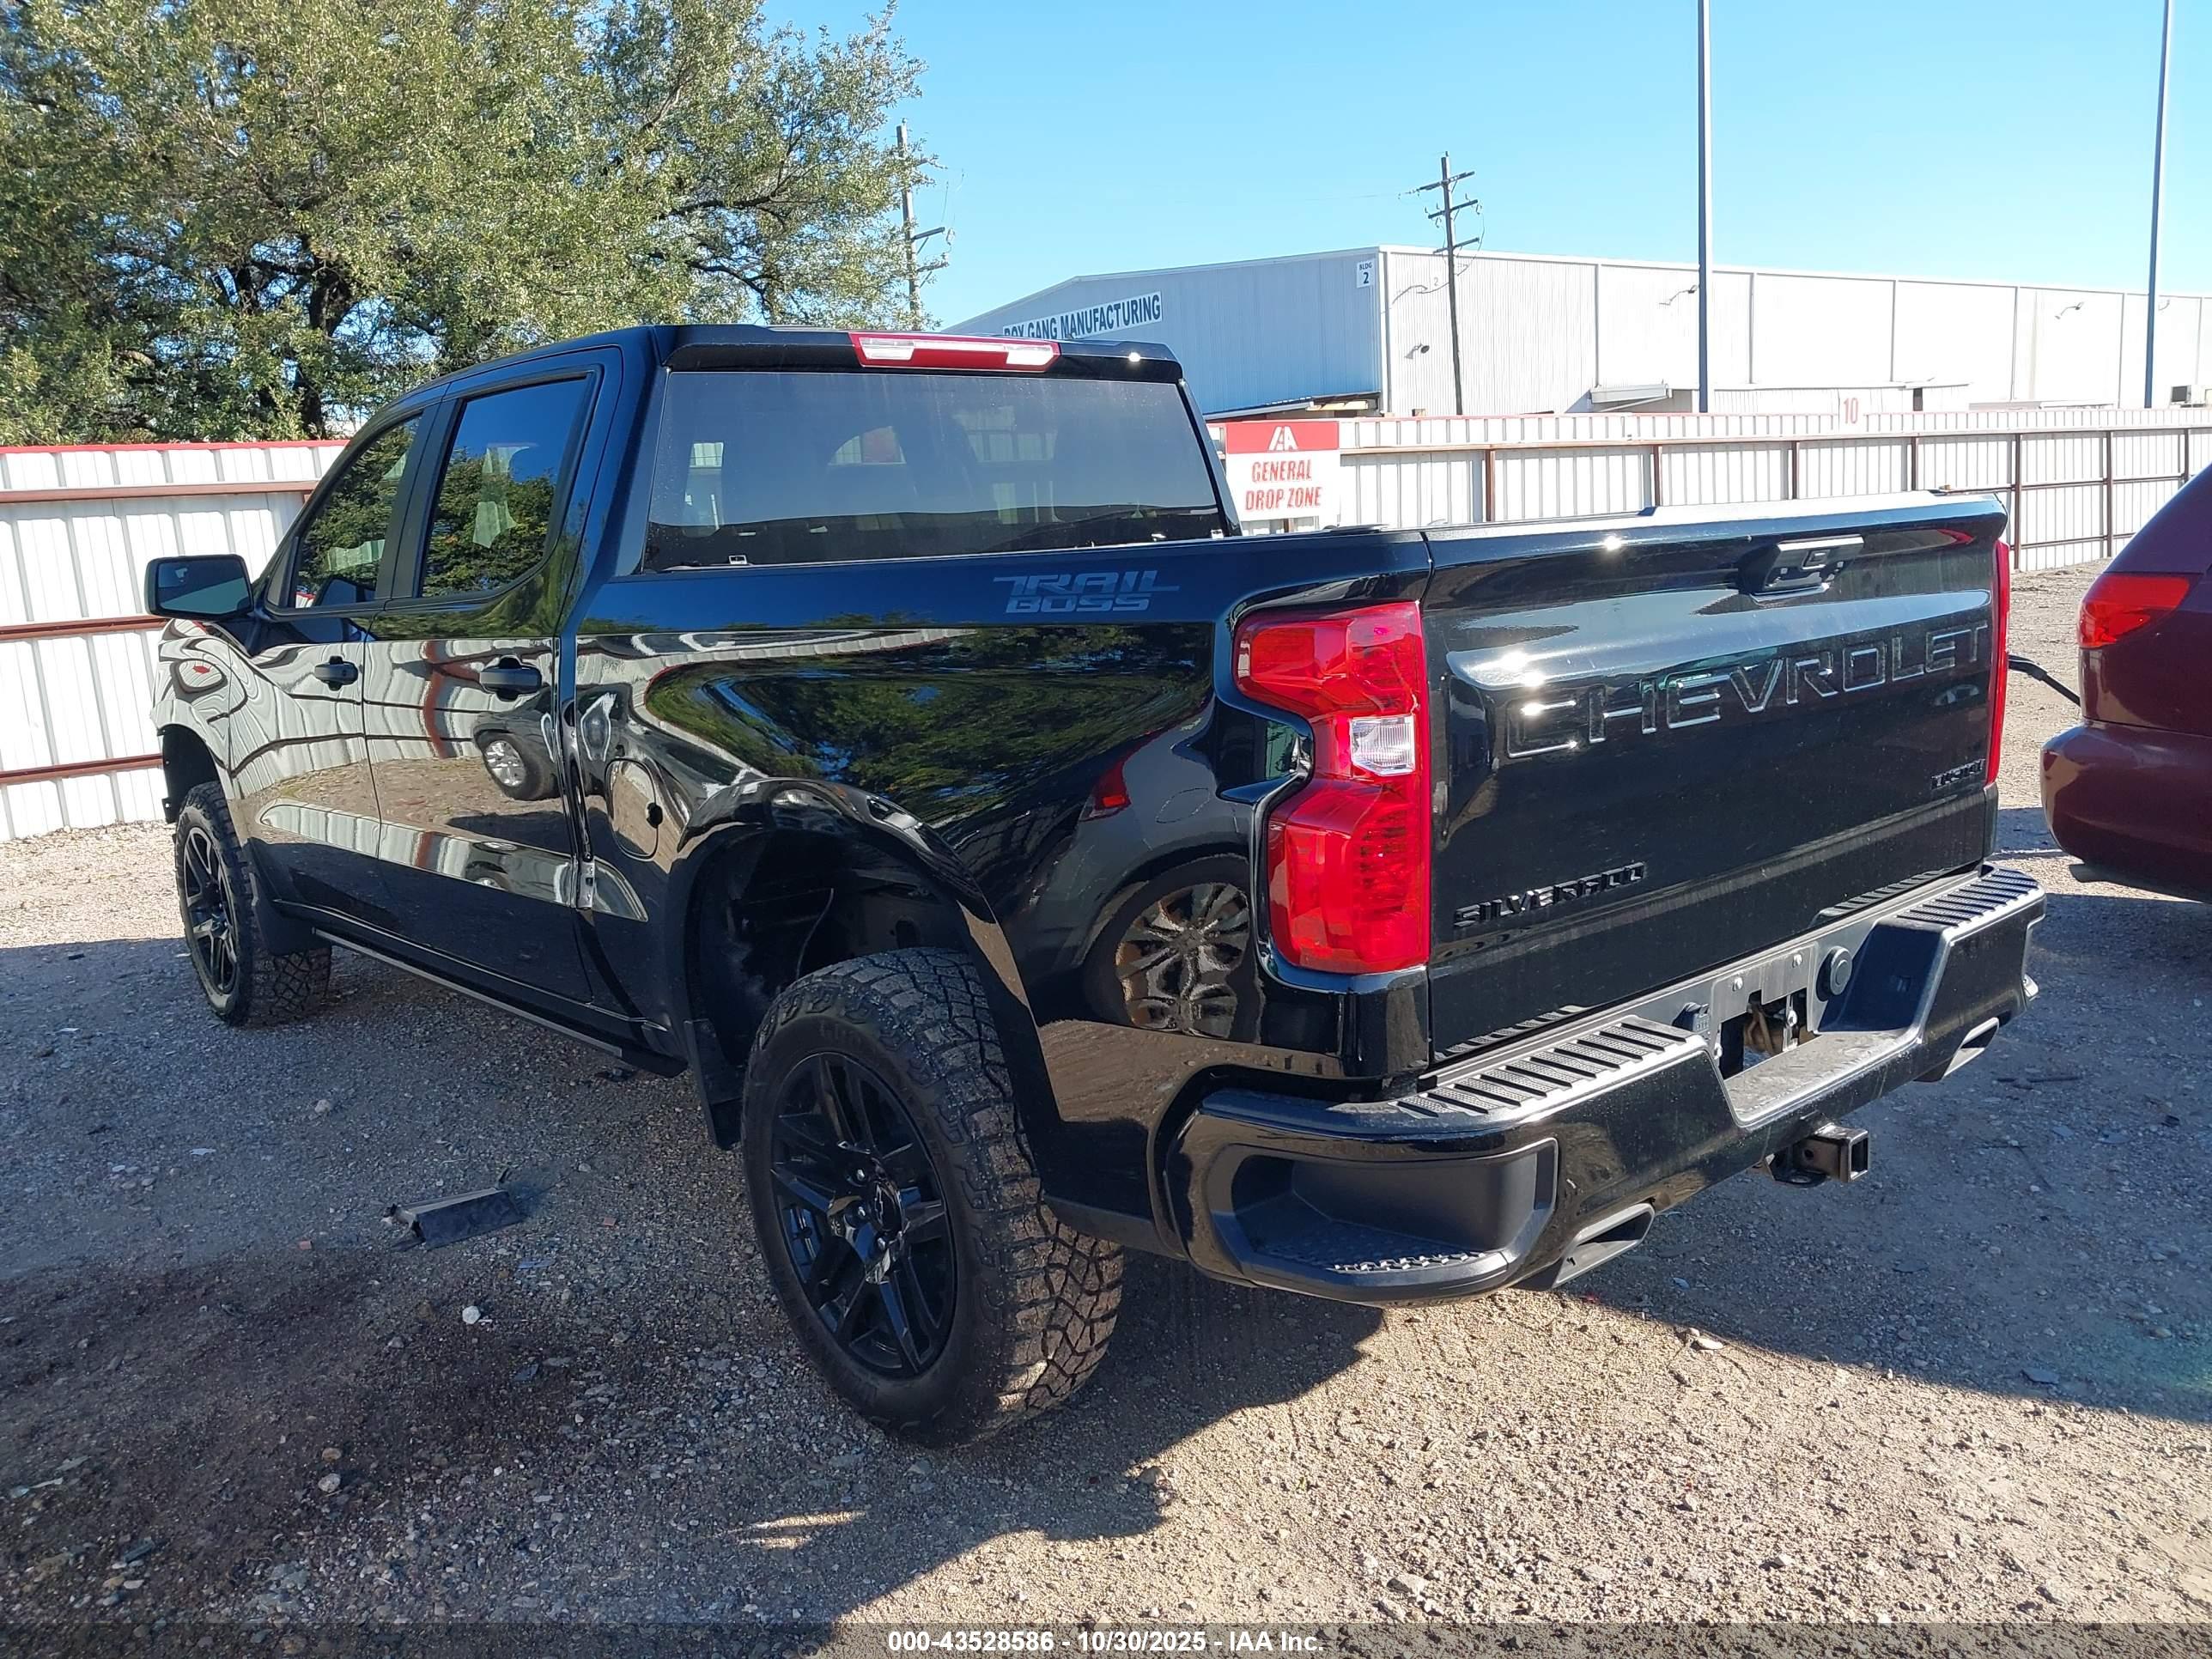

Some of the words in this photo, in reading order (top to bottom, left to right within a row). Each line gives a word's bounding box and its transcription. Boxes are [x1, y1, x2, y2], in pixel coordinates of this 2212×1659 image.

[1359, 262, 1372, 270] BLDG
[1363, 271, 1370, 284] 2
[1028, 318, 1057, 338] GANG
[1060, 295, 1161, 339] MANUFACTURING
[1843, 398, 1859, 424] 10
[1251, 459, 1313, 483] GENERAL
[1245, 488, 1284, 511] DROP
[1287, 486, 1322, 508] ZONE
[993, 570, 1180, 595] TRAIL
[1006, 592, 1152, 613] BOSS
[1505, 624, 1988, 759] CHEVROLET
[1453, 861, 1646, 927] SILVERADO
